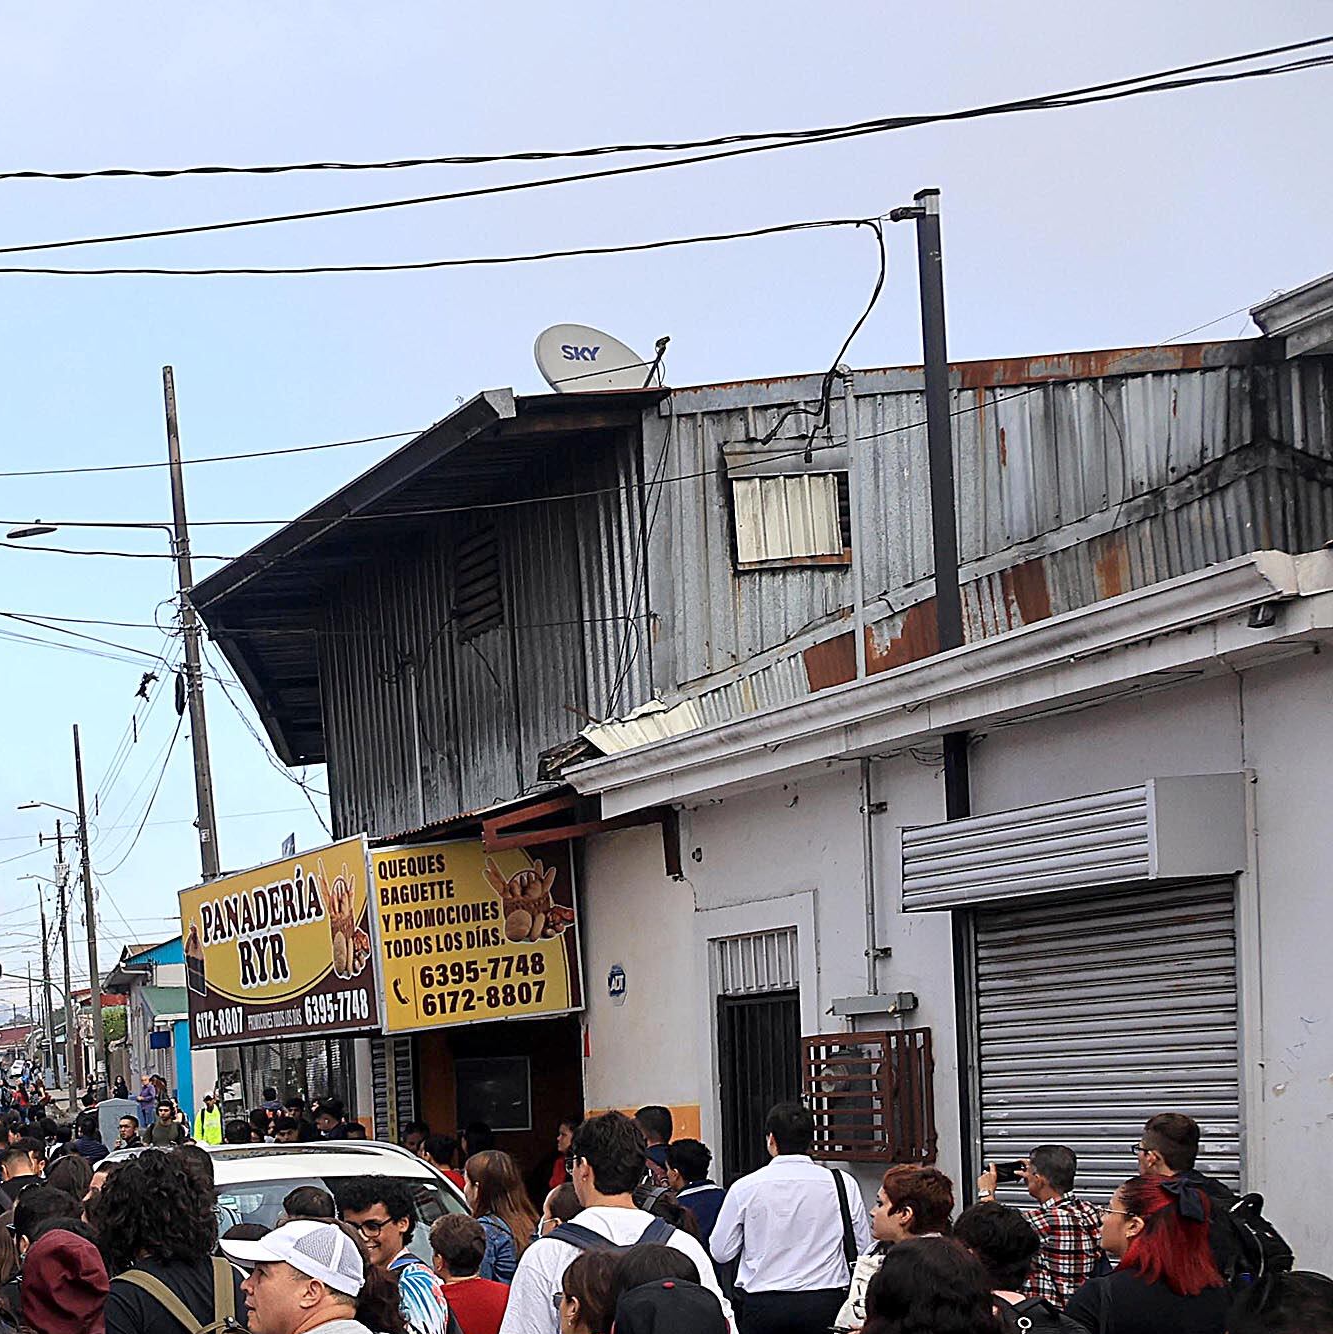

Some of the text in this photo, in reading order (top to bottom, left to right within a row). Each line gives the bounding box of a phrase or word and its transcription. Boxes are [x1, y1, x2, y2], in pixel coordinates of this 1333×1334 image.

[561, 345, 600, 361] SKY
[378, 853, 446, 881] QUEQUES
[201, 864, 324, 943] PANADERÍA
[381, 880, 454, 906] BAGUETTE
[382, 901, 499, 933] Y PROMOCIONES
[384, 926, 506, 959] TODOS LOS DÍAS.
[239, 933, 289, 986] RYR
[420, 952, 545, 988] 6395-7748
[422, 981, 546, 1016] 6172-8807
[610, 974, 624, 991] ADT
[196, 1007, 243, 1039] 6172-8807
[304, 988, 369, 1026] 6395-7748
